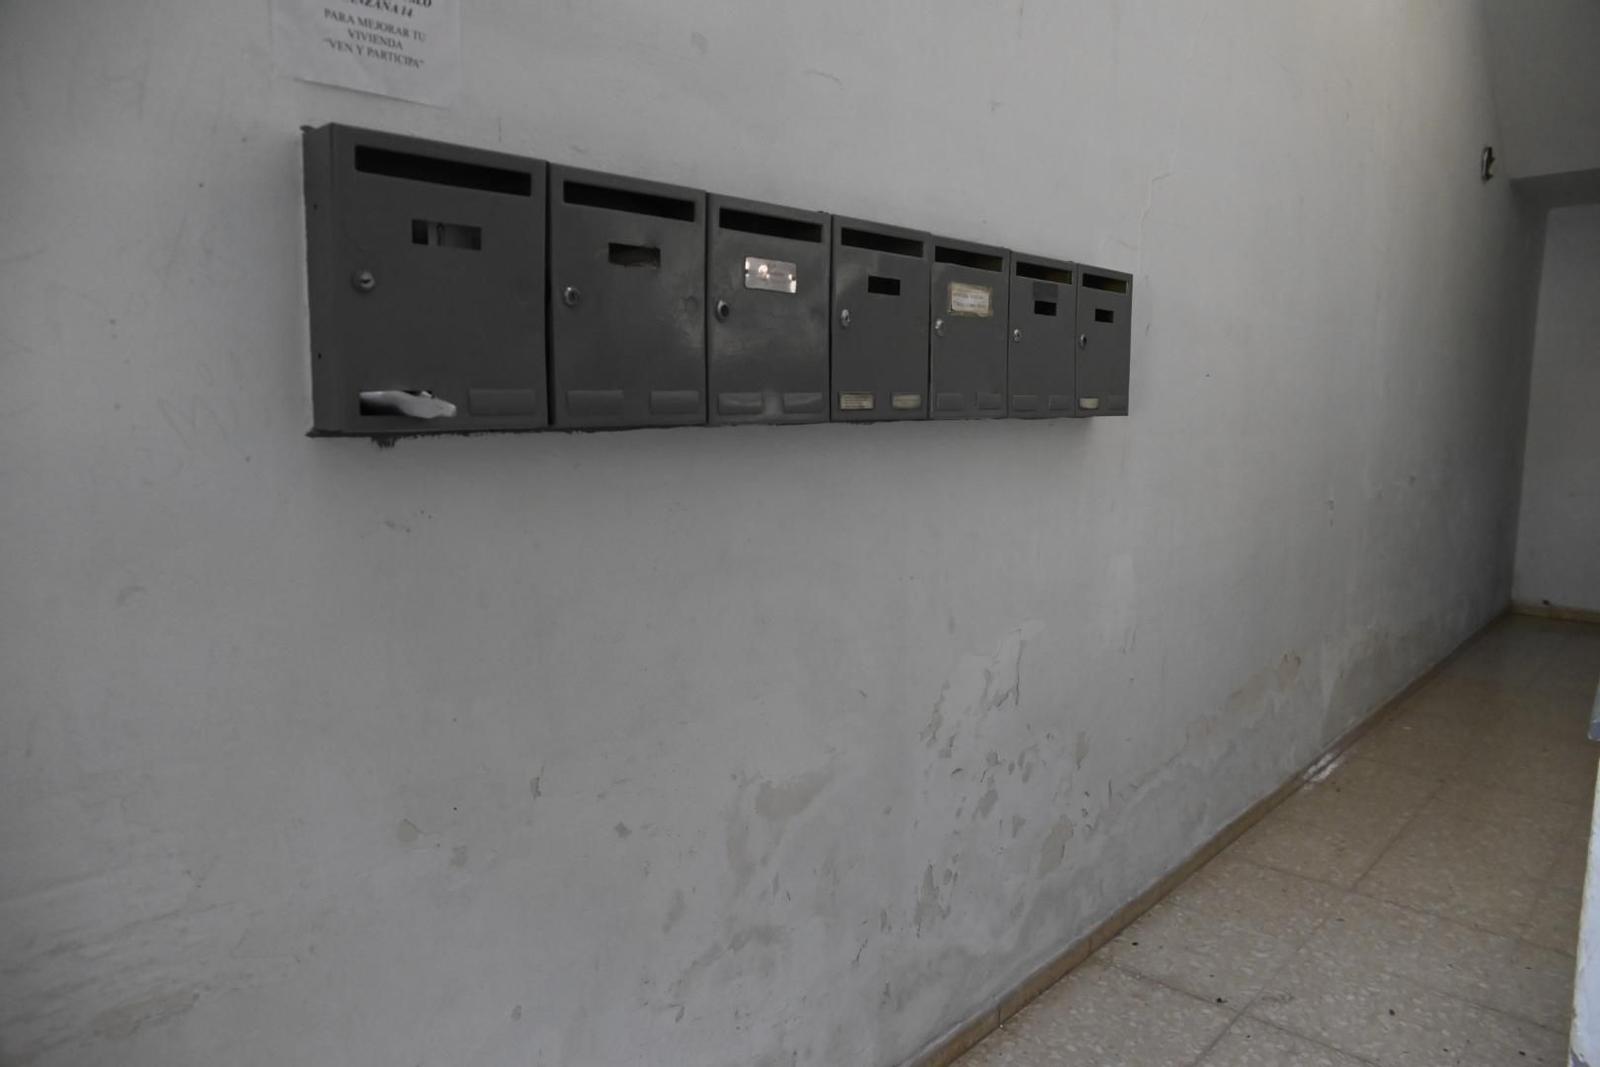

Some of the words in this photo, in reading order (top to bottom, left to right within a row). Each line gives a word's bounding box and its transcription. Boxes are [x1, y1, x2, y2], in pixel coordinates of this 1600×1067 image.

[342, 0, 397, 14] ZANA
[401, 6, 412, 18] 14
[324, 8, 355, 25] PARA
[357, 16, 409, 38] MEJORAR
[413, 30, 426, 42] TU
[347, 28, 403, 50] VIVIENDA
[356, 44, 364, 56] Y
